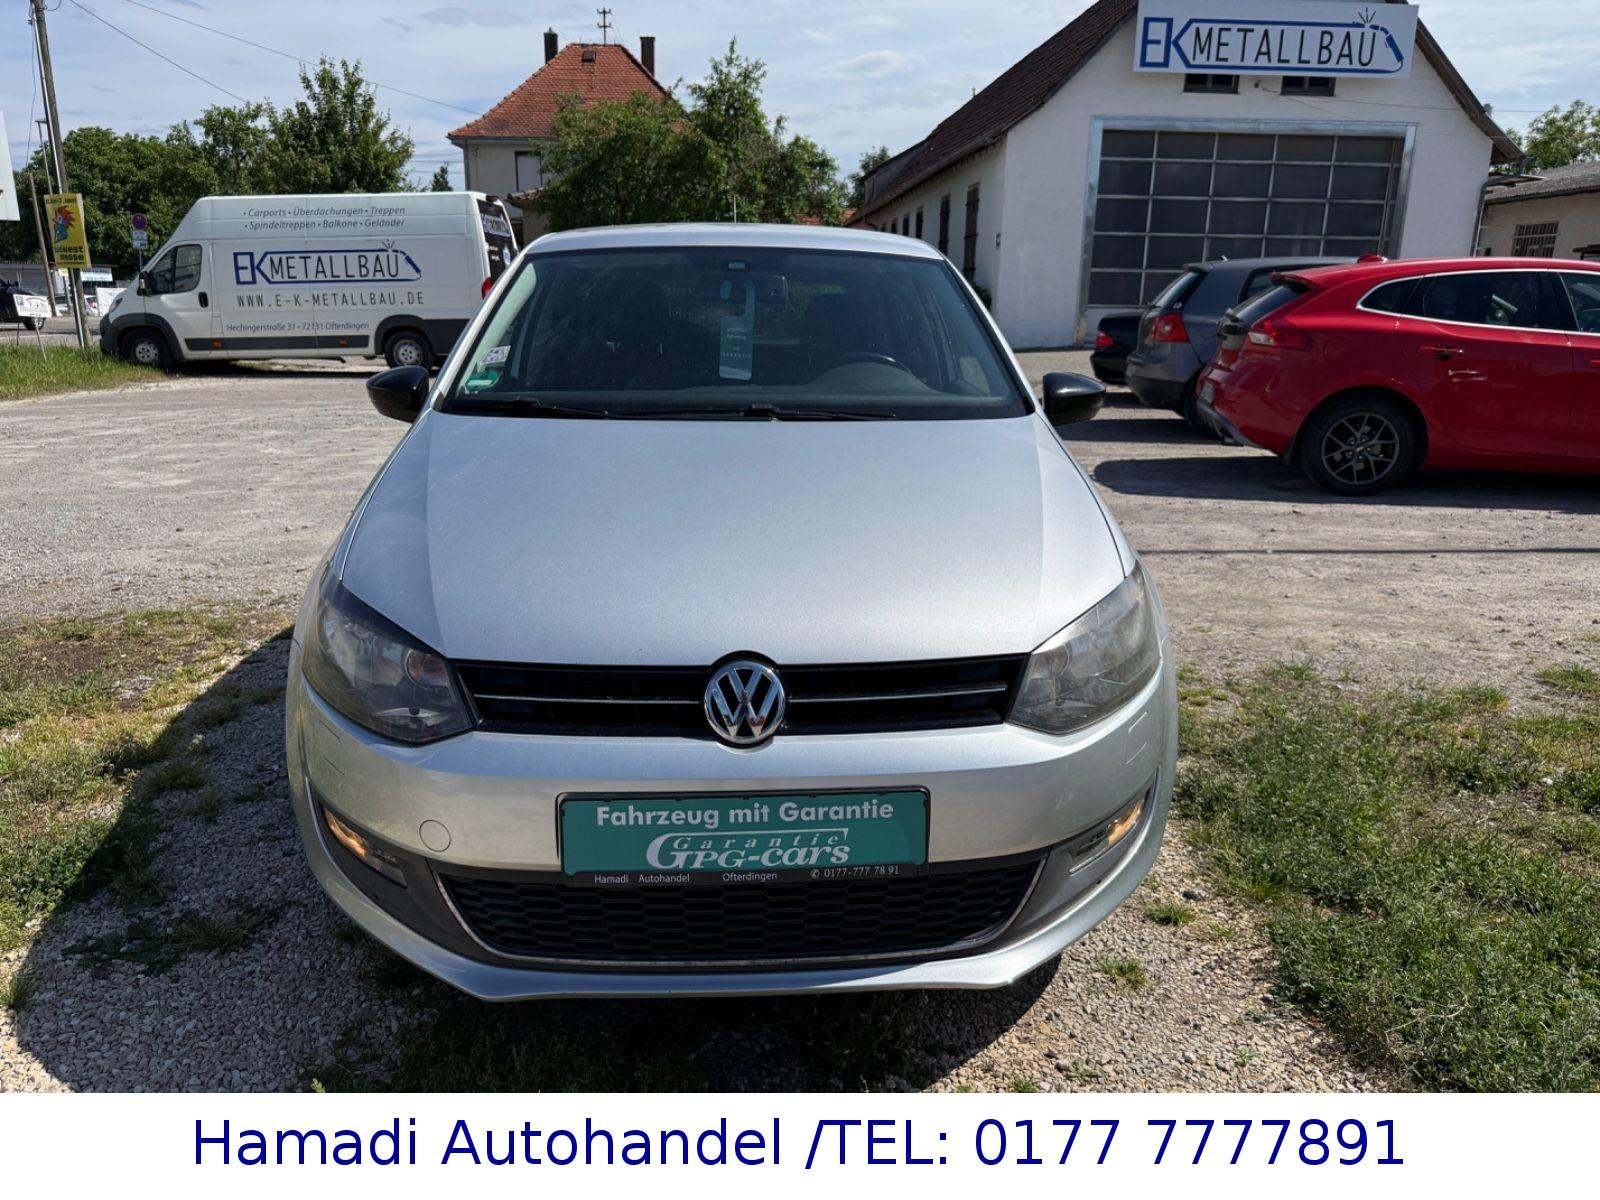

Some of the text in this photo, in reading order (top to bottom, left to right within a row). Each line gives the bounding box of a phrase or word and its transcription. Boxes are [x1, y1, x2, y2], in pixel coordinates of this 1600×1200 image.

[1191, 26, 1377, 67] METALLBAU
[248, 206, 406, 218] Carports Überdachungen Treppen
[249, 217, 405, 230] Spindeltreppen Balkone Geländer
[269, 254, 400, 280] METALLBAU
[236, 291, 424, 308] WWW.E-K-METALLBAU.DE
[226, 321, 370, 333] Hechingerstraße 31 72131 Ofterdingen
[596, 799, 894, 829] Fahrzeug mit Garantie
[673, 833, 839, 850] Garantie
[594, 864, 899, 884] Hamadi Autohandel Ofterdingen 0177-777 78 91
